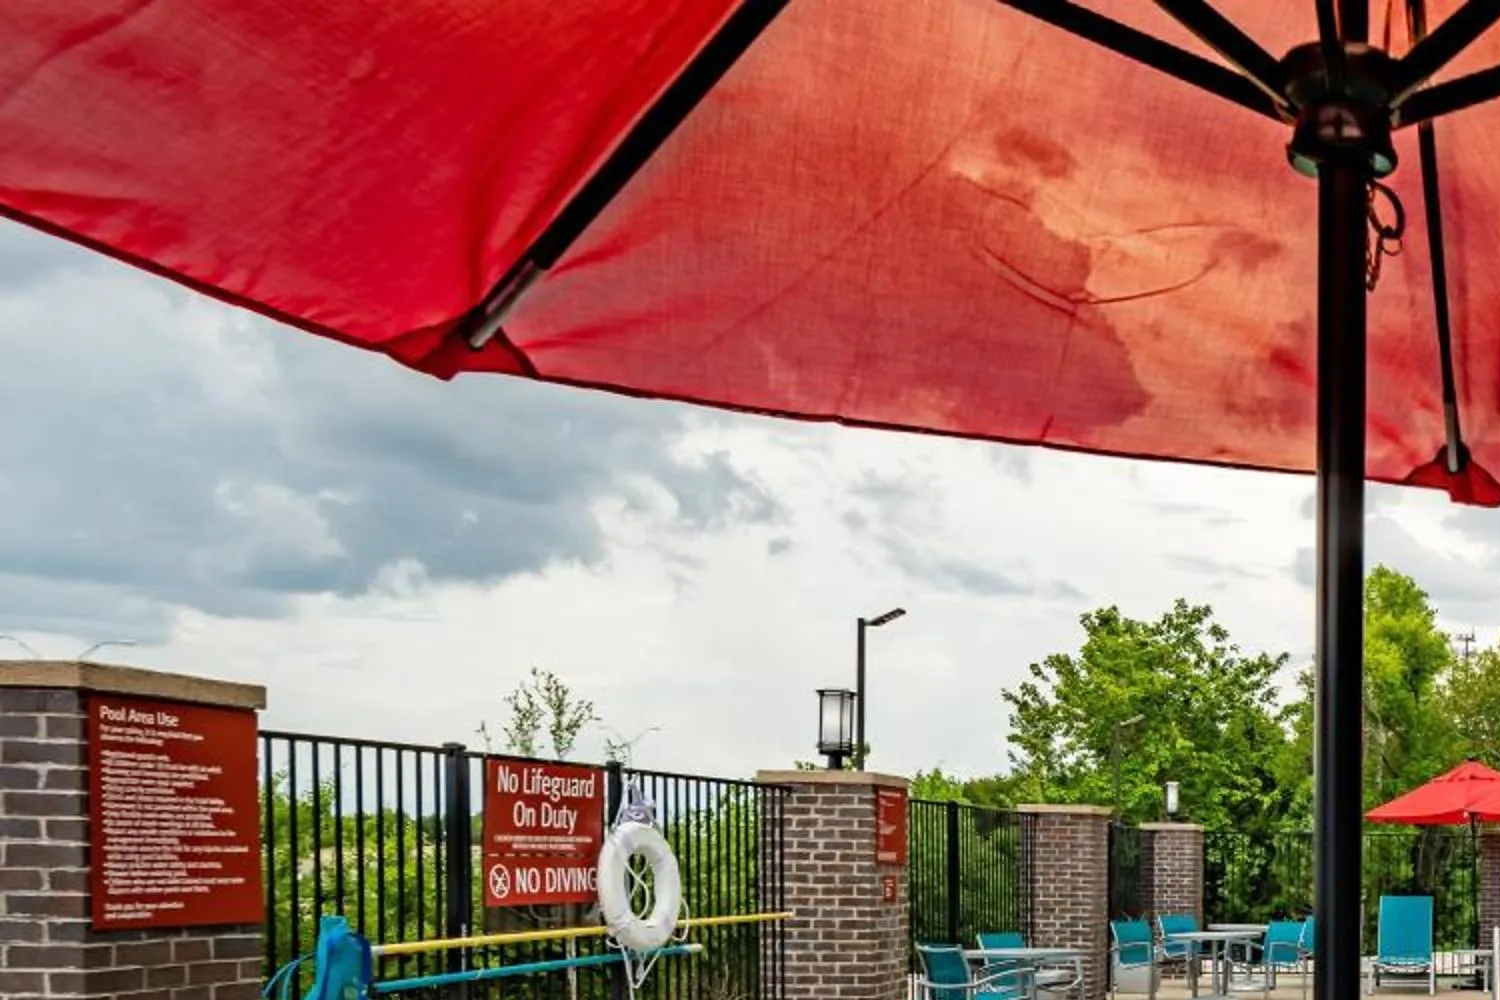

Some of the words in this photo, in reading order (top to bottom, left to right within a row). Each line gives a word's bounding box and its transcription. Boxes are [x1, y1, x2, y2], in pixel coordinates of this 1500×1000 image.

[100, 705, 126, 721] Pool
[157, 711, 179, 727] Use
[497, 766, 519, 793] No
[523, 769, 595, 801] Lifeguard
[513, 801, 536, 828] On
[541, 803, 578, 834] Duty
[516, 867, 540, 893] NO
[545, 867, 598, 893] DIVING
